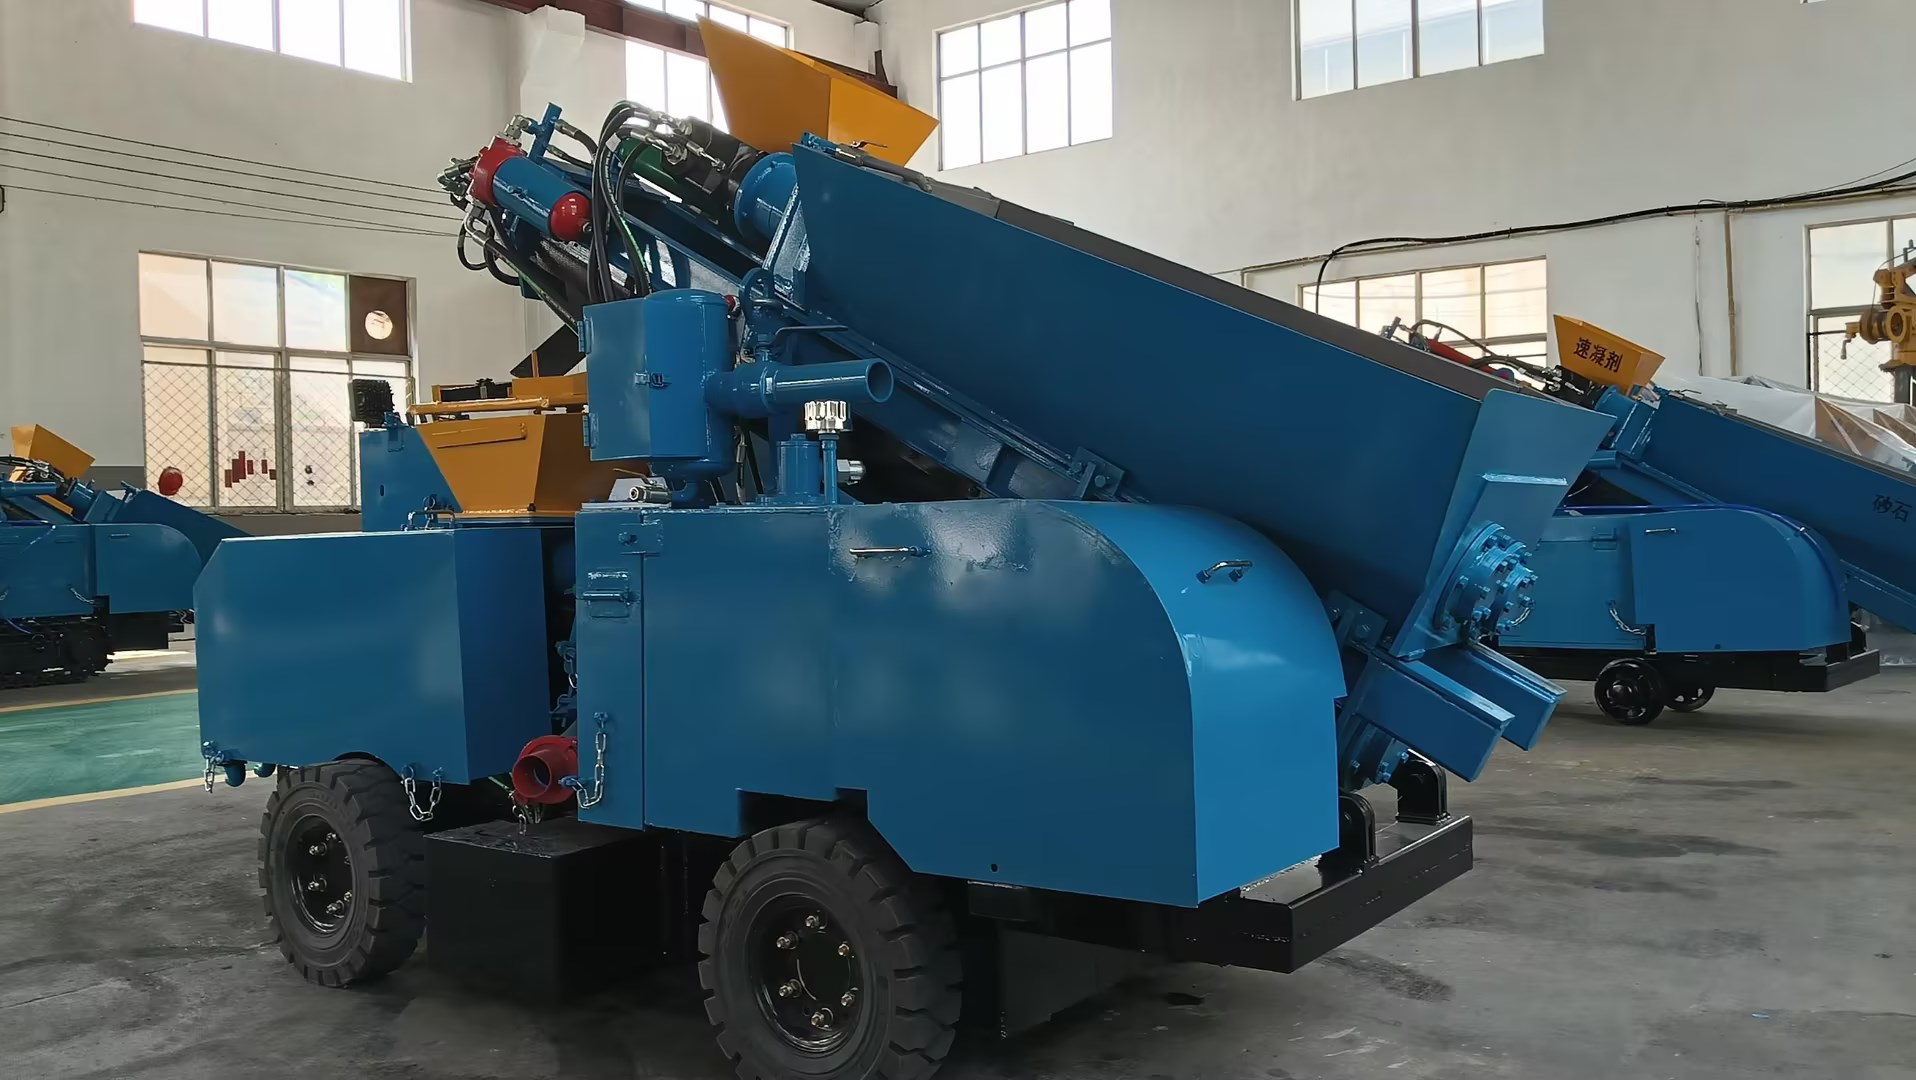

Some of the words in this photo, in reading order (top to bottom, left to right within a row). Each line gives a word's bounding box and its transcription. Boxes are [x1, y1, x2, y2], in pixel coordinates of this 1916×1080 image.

[1573, 337, 1623, 373] 速凝剂
[1872, 494, 1912, 523] 砂石
